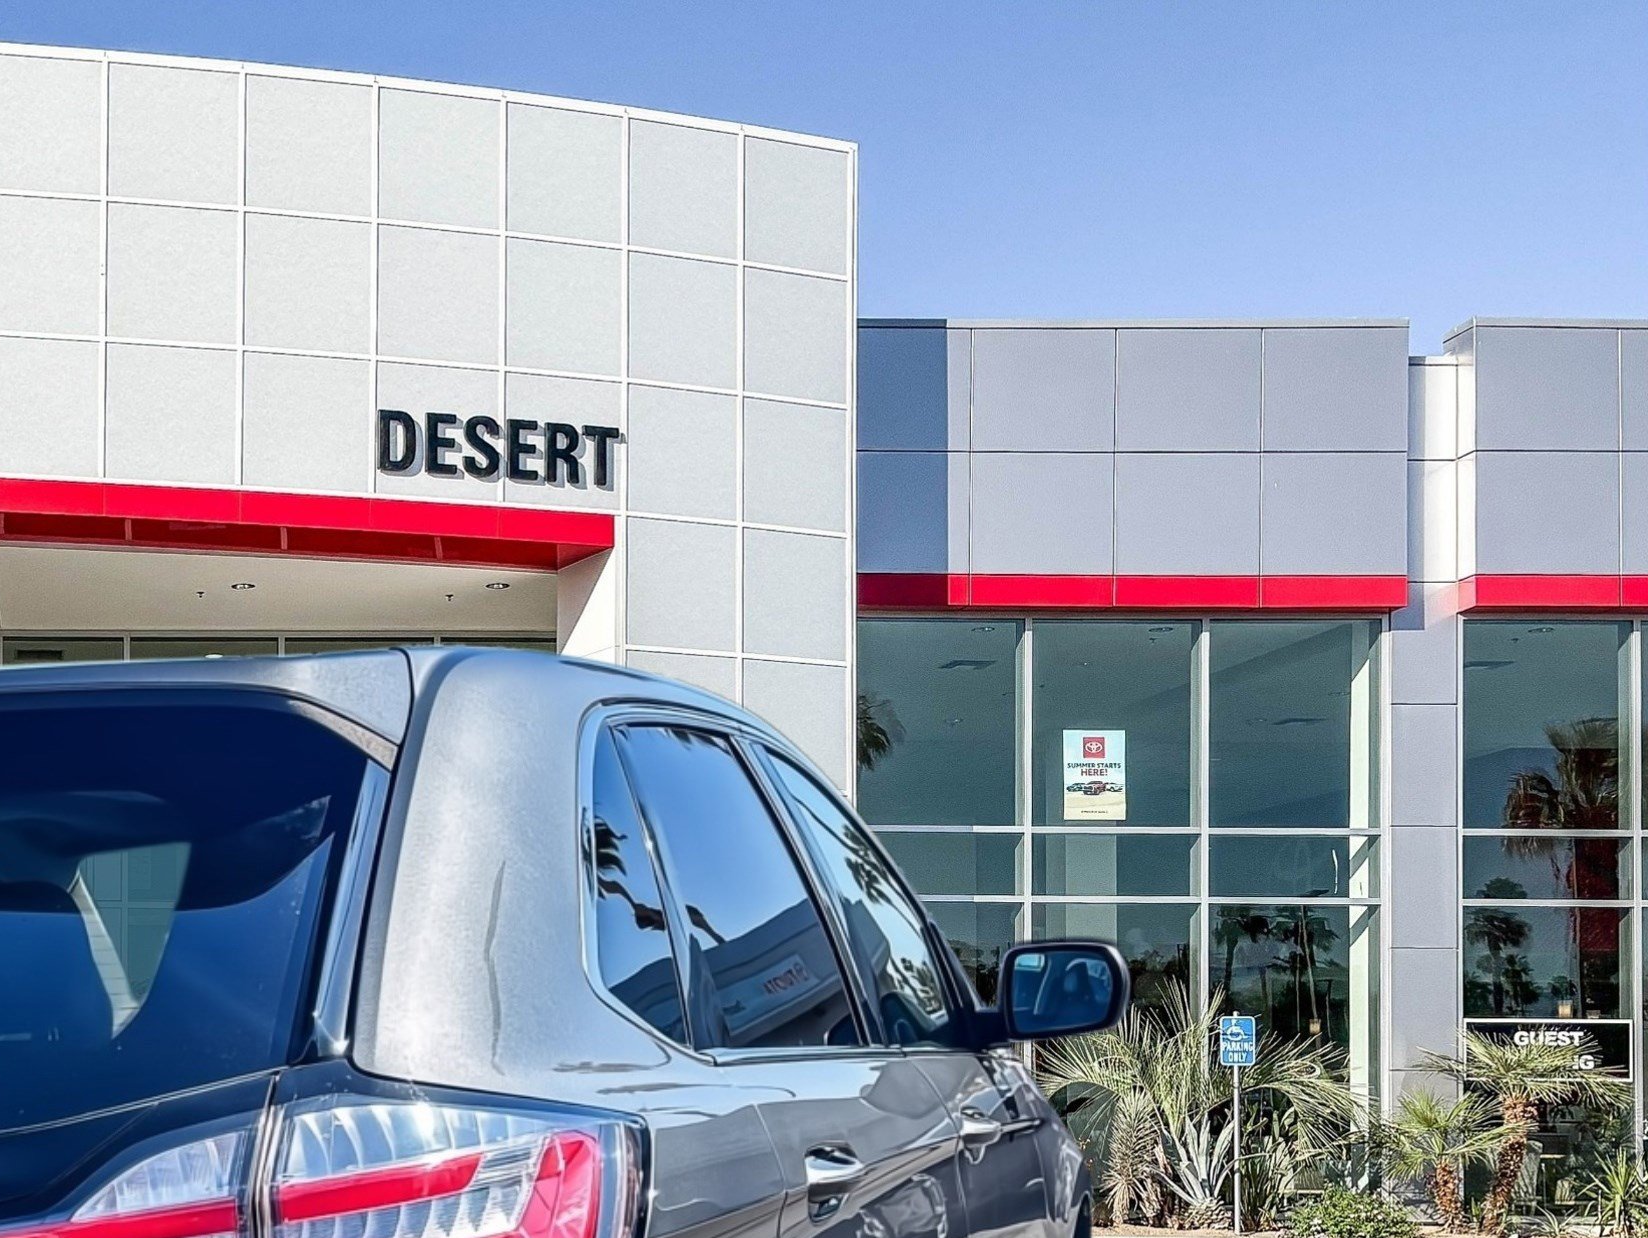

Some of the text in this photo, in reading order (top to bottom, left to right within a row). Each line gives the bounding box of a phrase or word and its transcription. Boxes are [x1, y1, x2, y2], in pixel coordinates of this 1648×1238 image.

[377, 409, 621, 487] DESERT
[1222, 1041, 1253, 1051] PARKING
[1513, 1031, 1584, 1047] GUEST
[1228, 1051, 1247, 1063] ONLY
